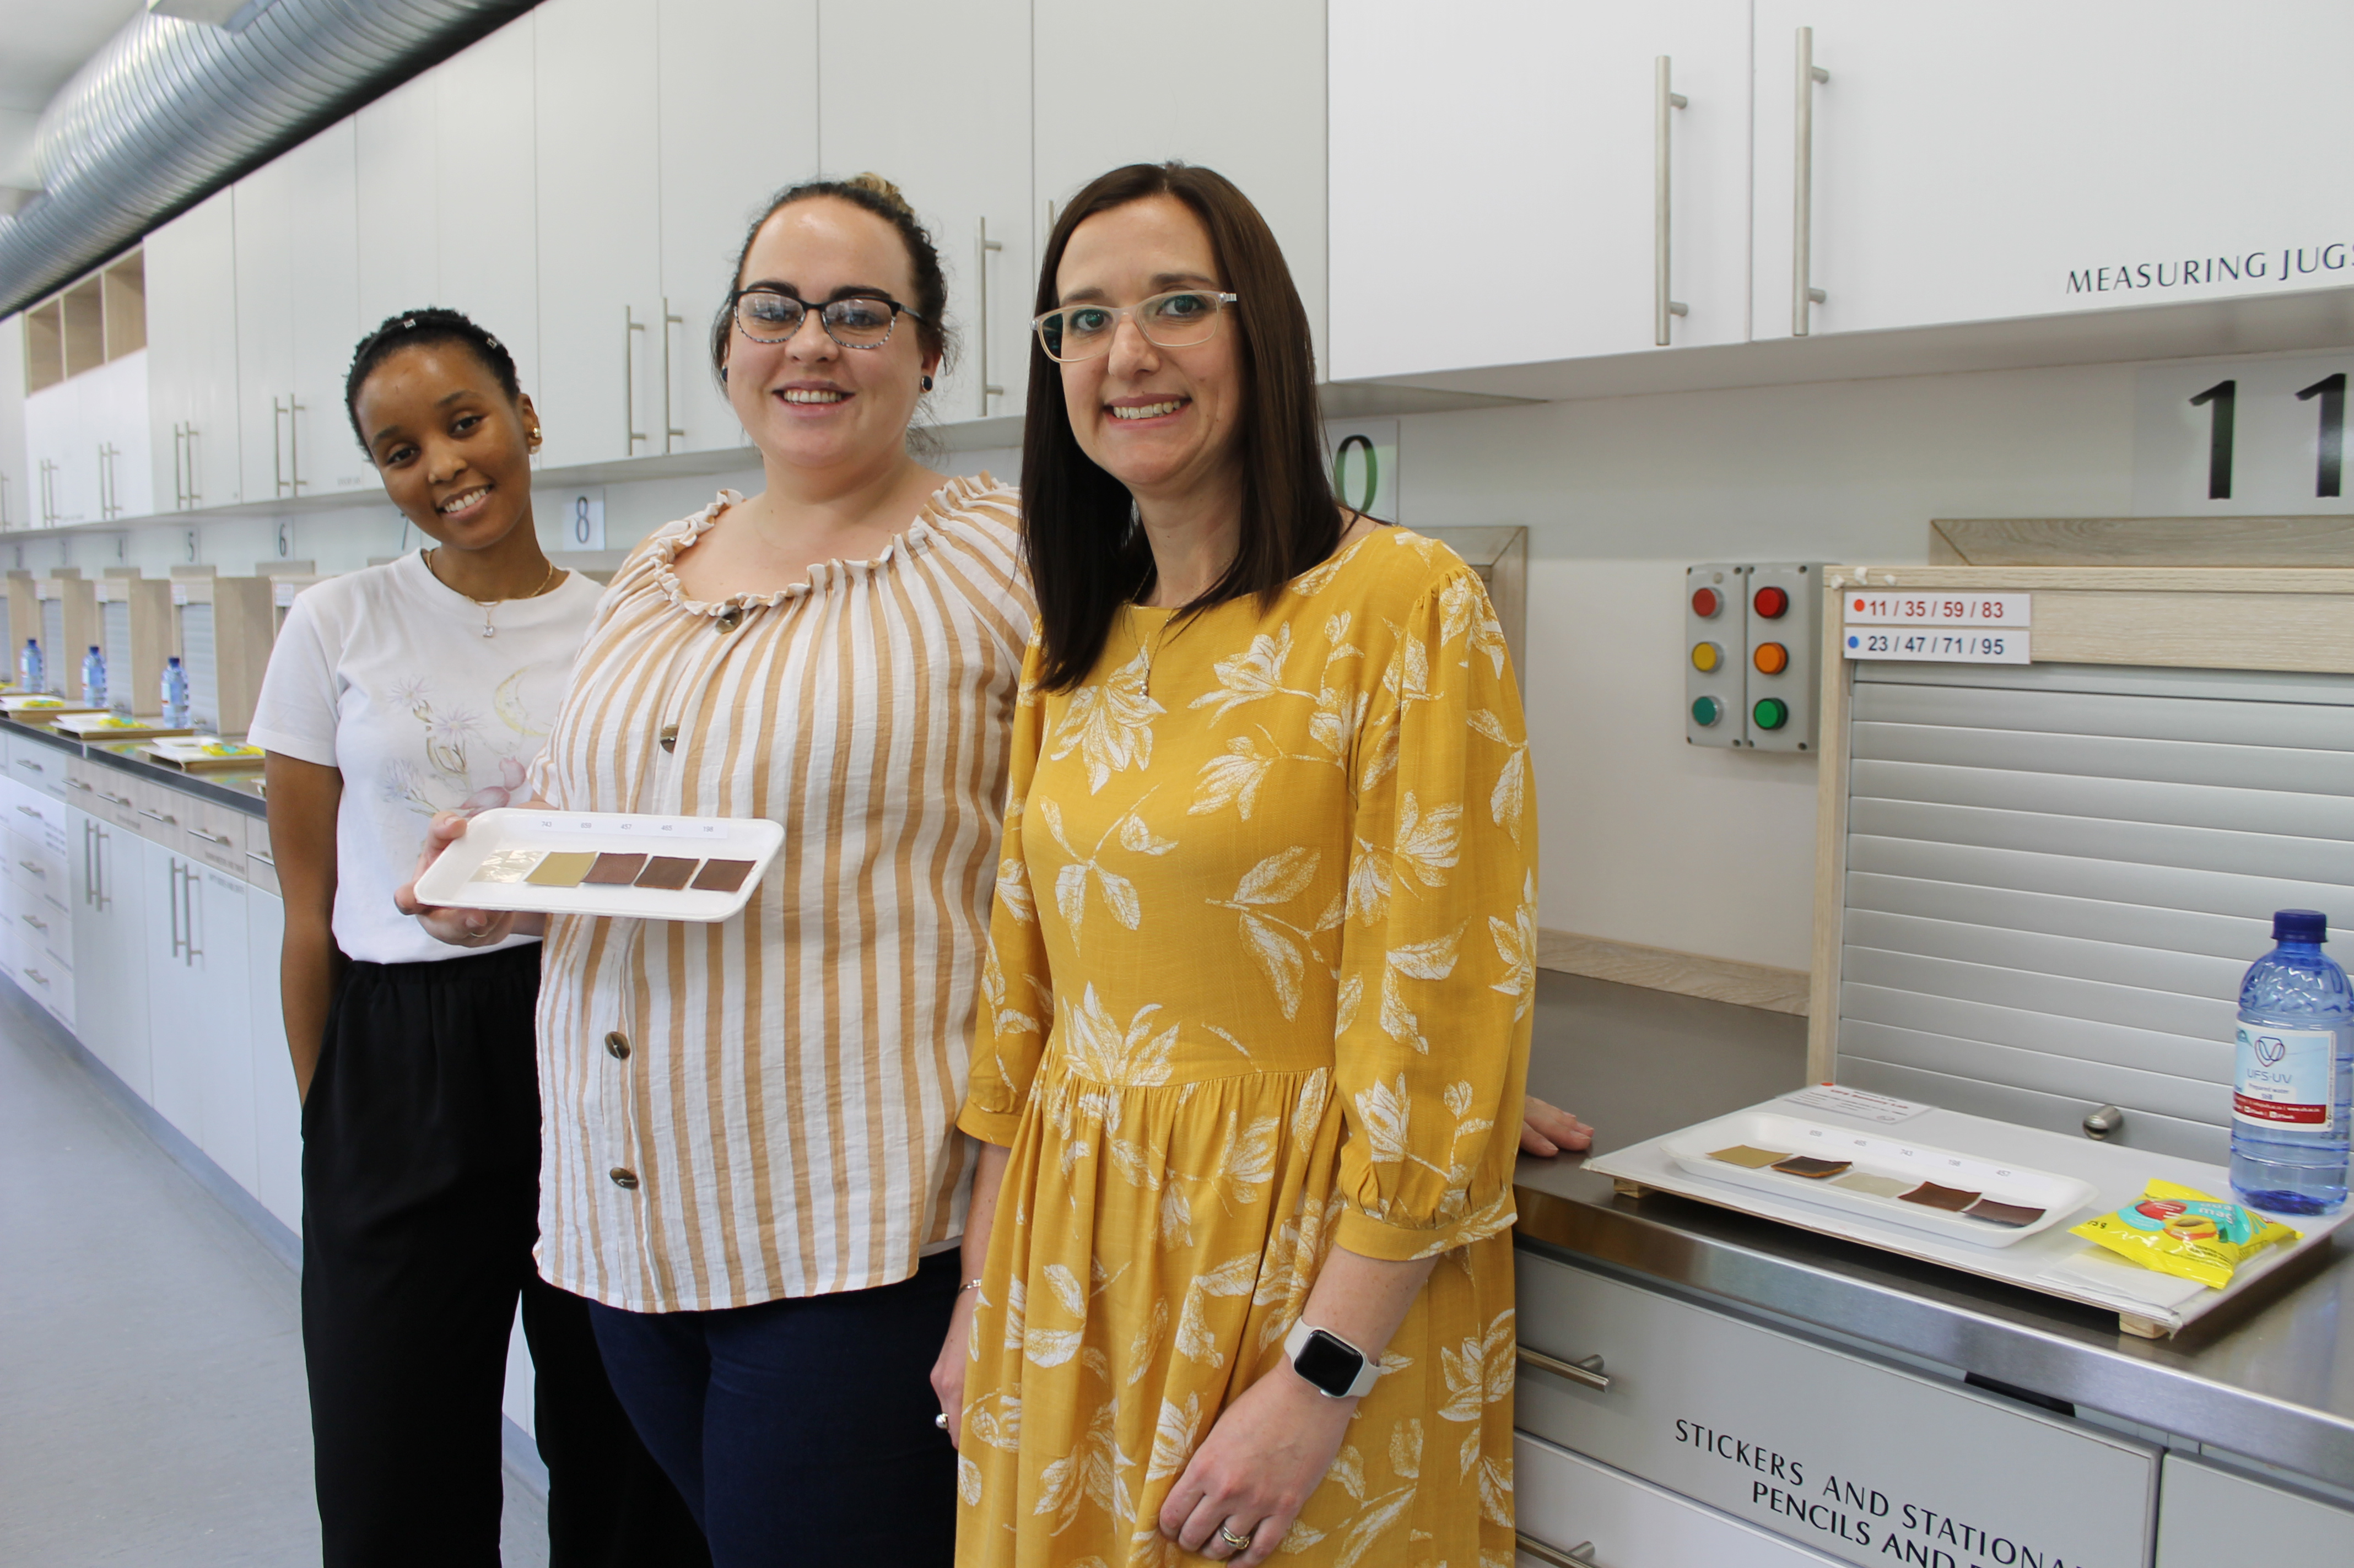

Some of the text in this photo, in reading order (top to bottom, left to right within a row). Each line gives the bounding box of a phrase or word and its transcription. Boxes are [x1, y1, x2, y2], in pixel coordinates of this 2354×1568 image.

[2066, 244, 2354, 295] MEASURING JUG
[2189, 372, 2348, 499] 11
[279, 523, 287, 557] 6
[576, 496, 590, 544] 8
[1870, 601, 1886, 616] 11
[1905, 601, 1926, 617] 35
[1943, 602, 1964, 617] 59
[1982, 602, 2004, 618] 83
[1868, 636, 1888, 652] 23
[1904, 637, 1926, 652] 47
[1943, 638, 1963, 653] 71
[1982, 639, 2004, 655] 95
[1676, 1419, 1803, 1486] STICKERS
[1822, 1475, 1888, 1517] AND
[1753, 1480, 1956, 1568] PENCILS AND
